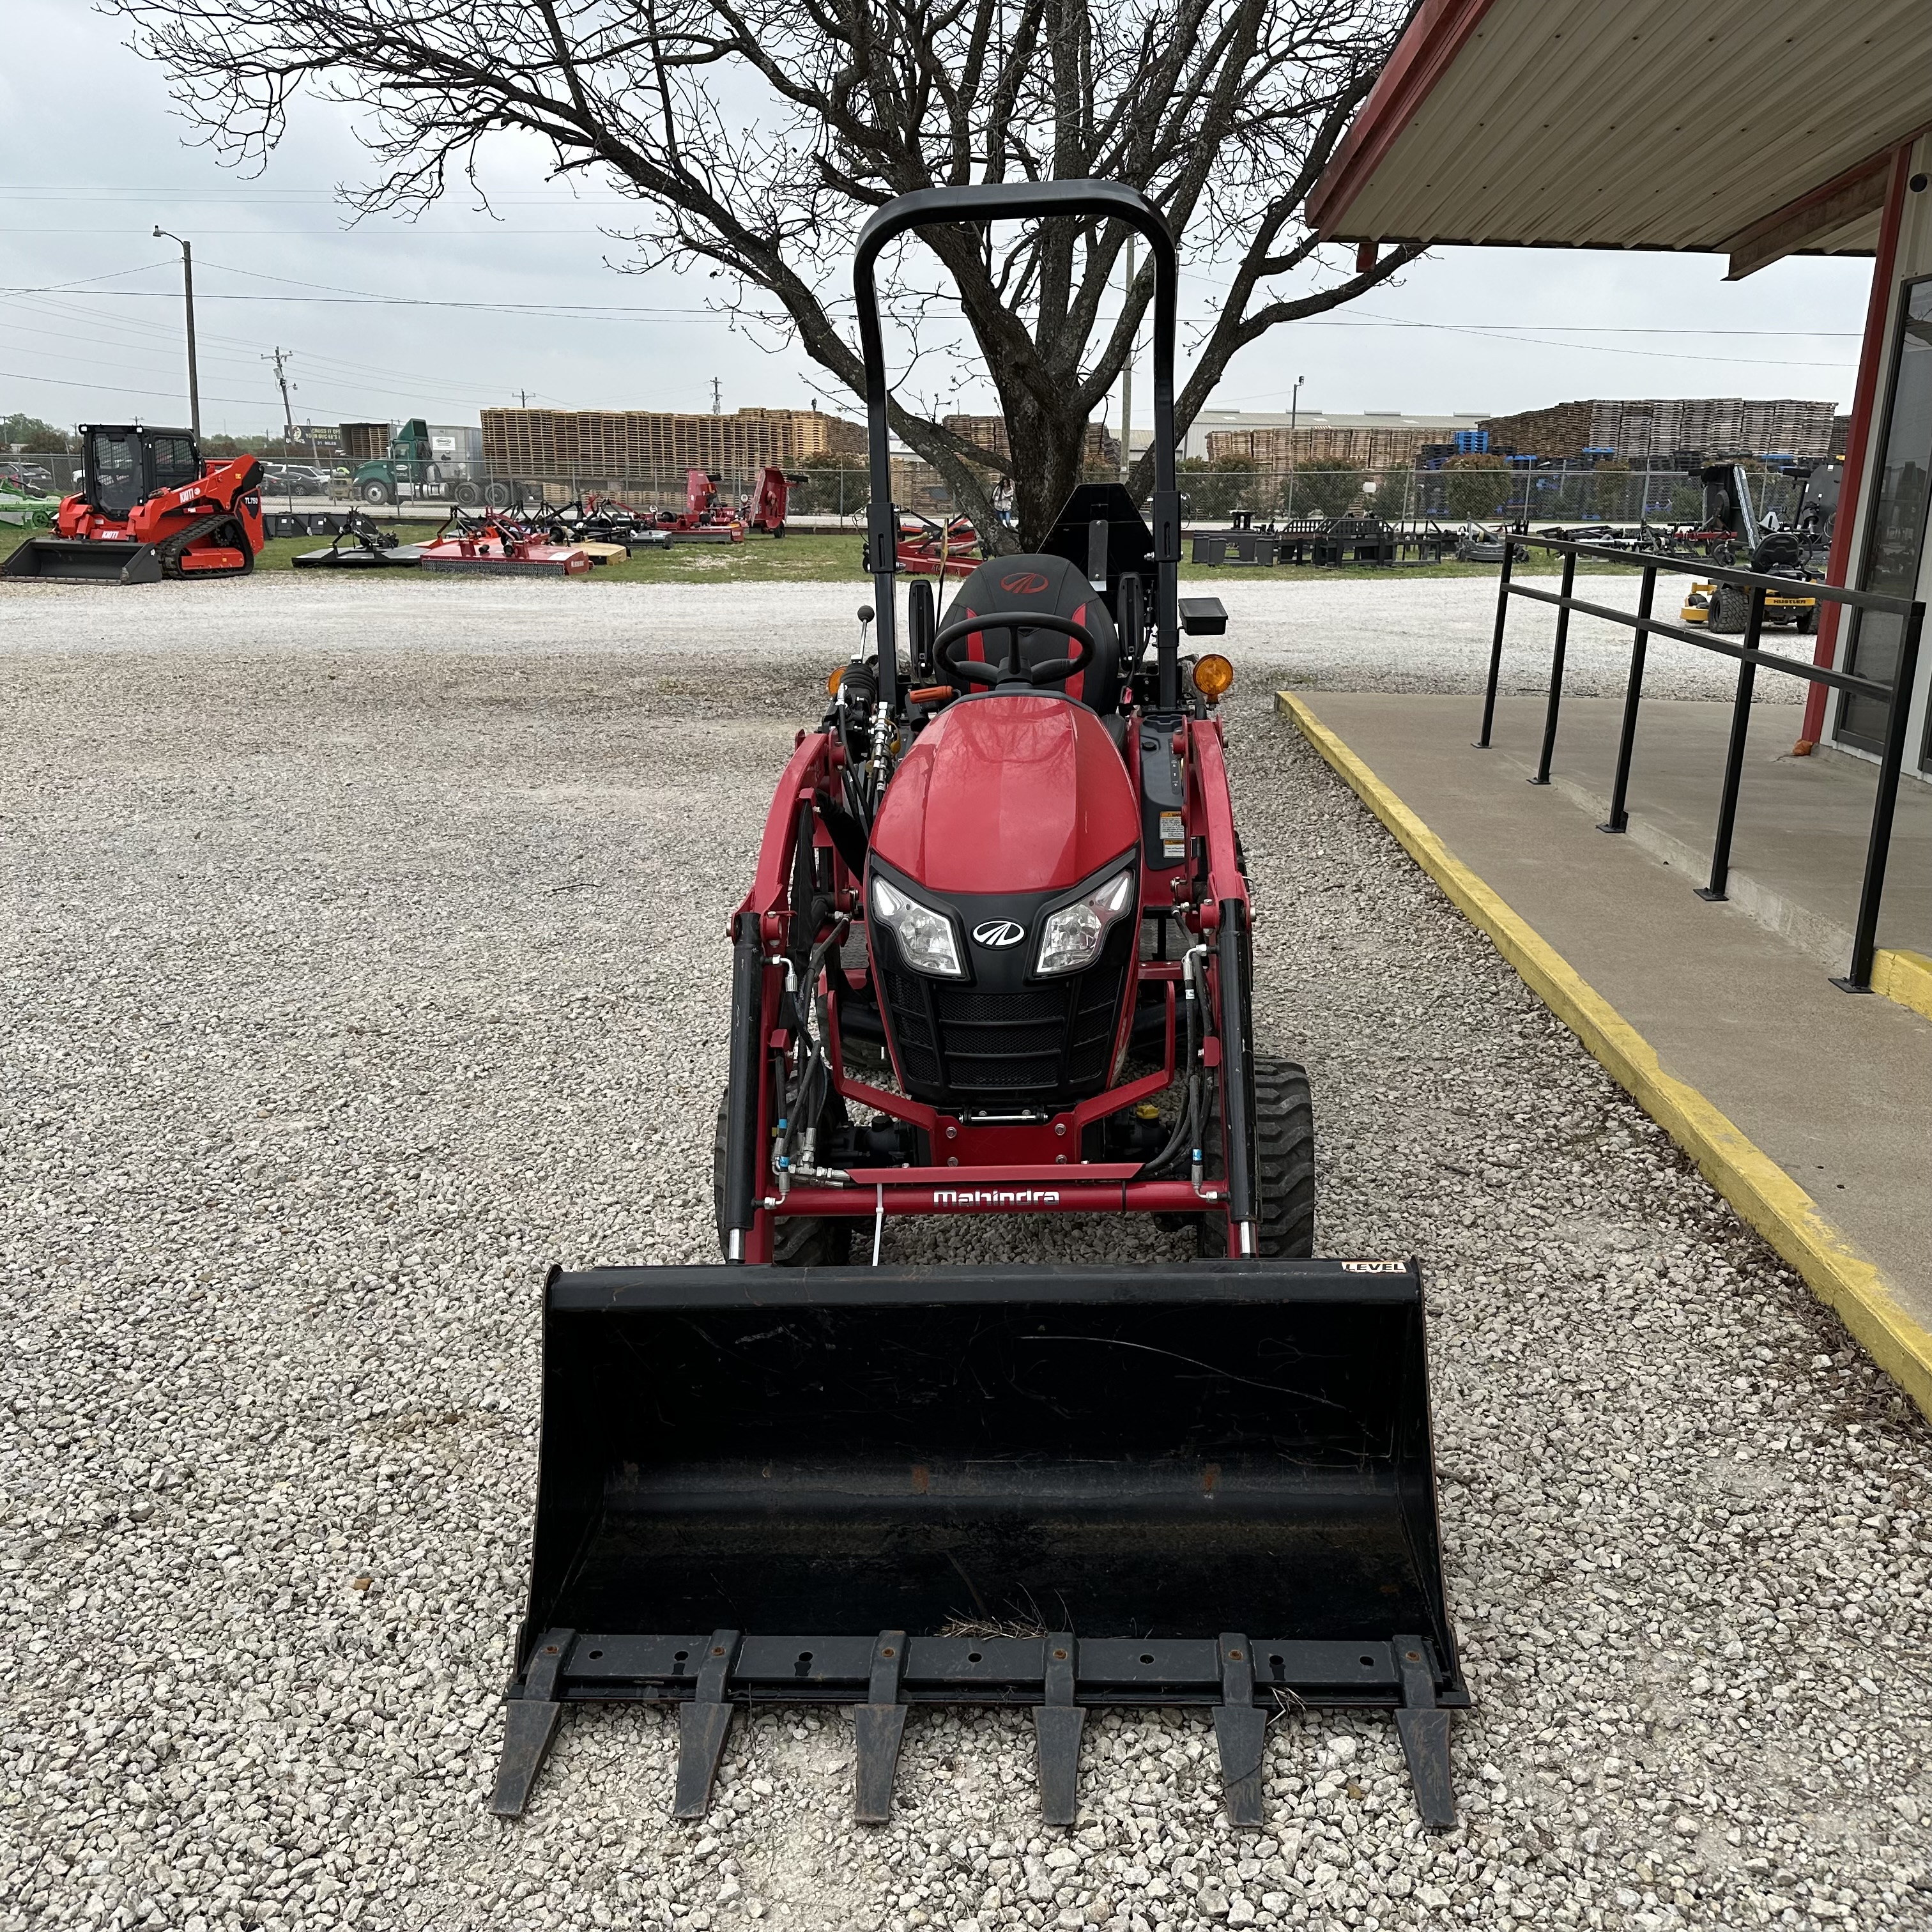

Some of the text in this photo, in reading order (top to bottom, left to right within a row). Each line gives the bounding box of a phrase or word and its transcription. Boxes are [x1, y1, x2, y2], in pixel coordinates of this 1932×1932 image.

[180, 487, 194, 503] KIOTI
[102, 530, 119, 539] KIOTI
[933, 1188, 1060, 1206] Mahindra
